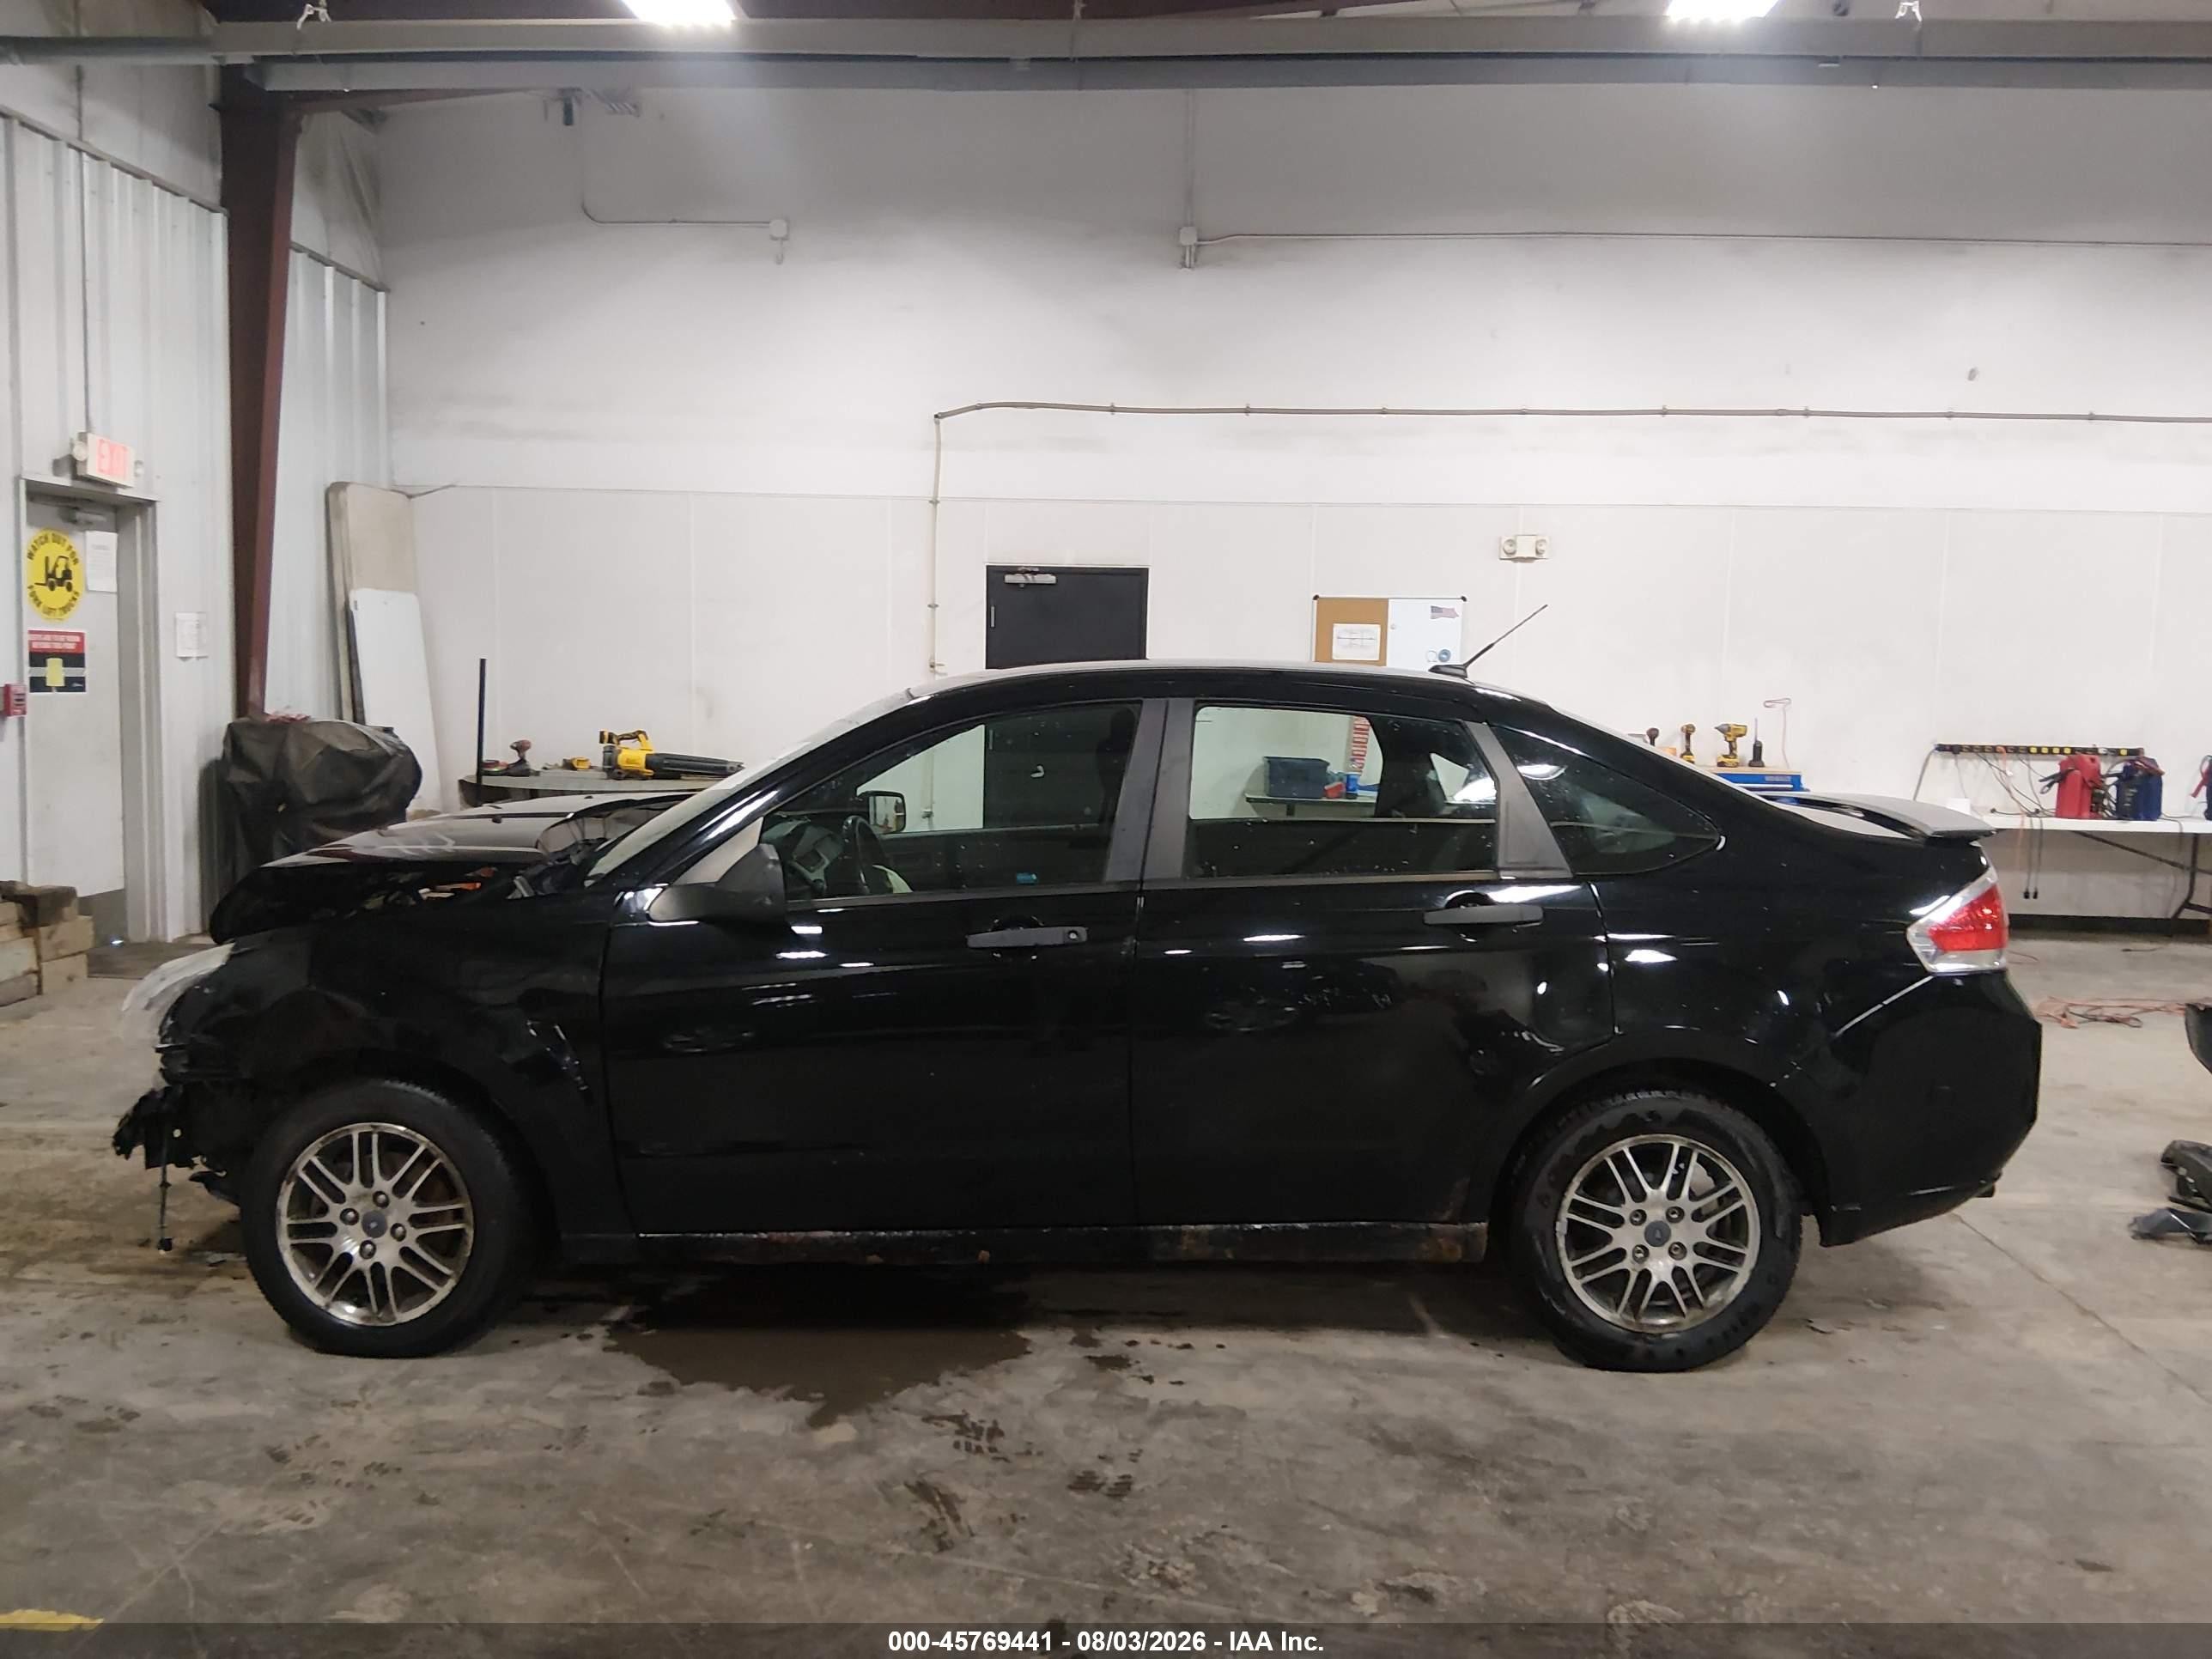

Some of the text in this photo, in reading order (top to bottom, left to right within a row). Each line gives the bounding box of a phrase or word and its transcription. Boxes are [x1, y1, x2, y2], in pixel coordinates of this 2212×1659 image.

[96, 438, 129, 477] EXIT
[27, 532, 48, 560] WATCH
[66, 544, 80, 565] FOR
